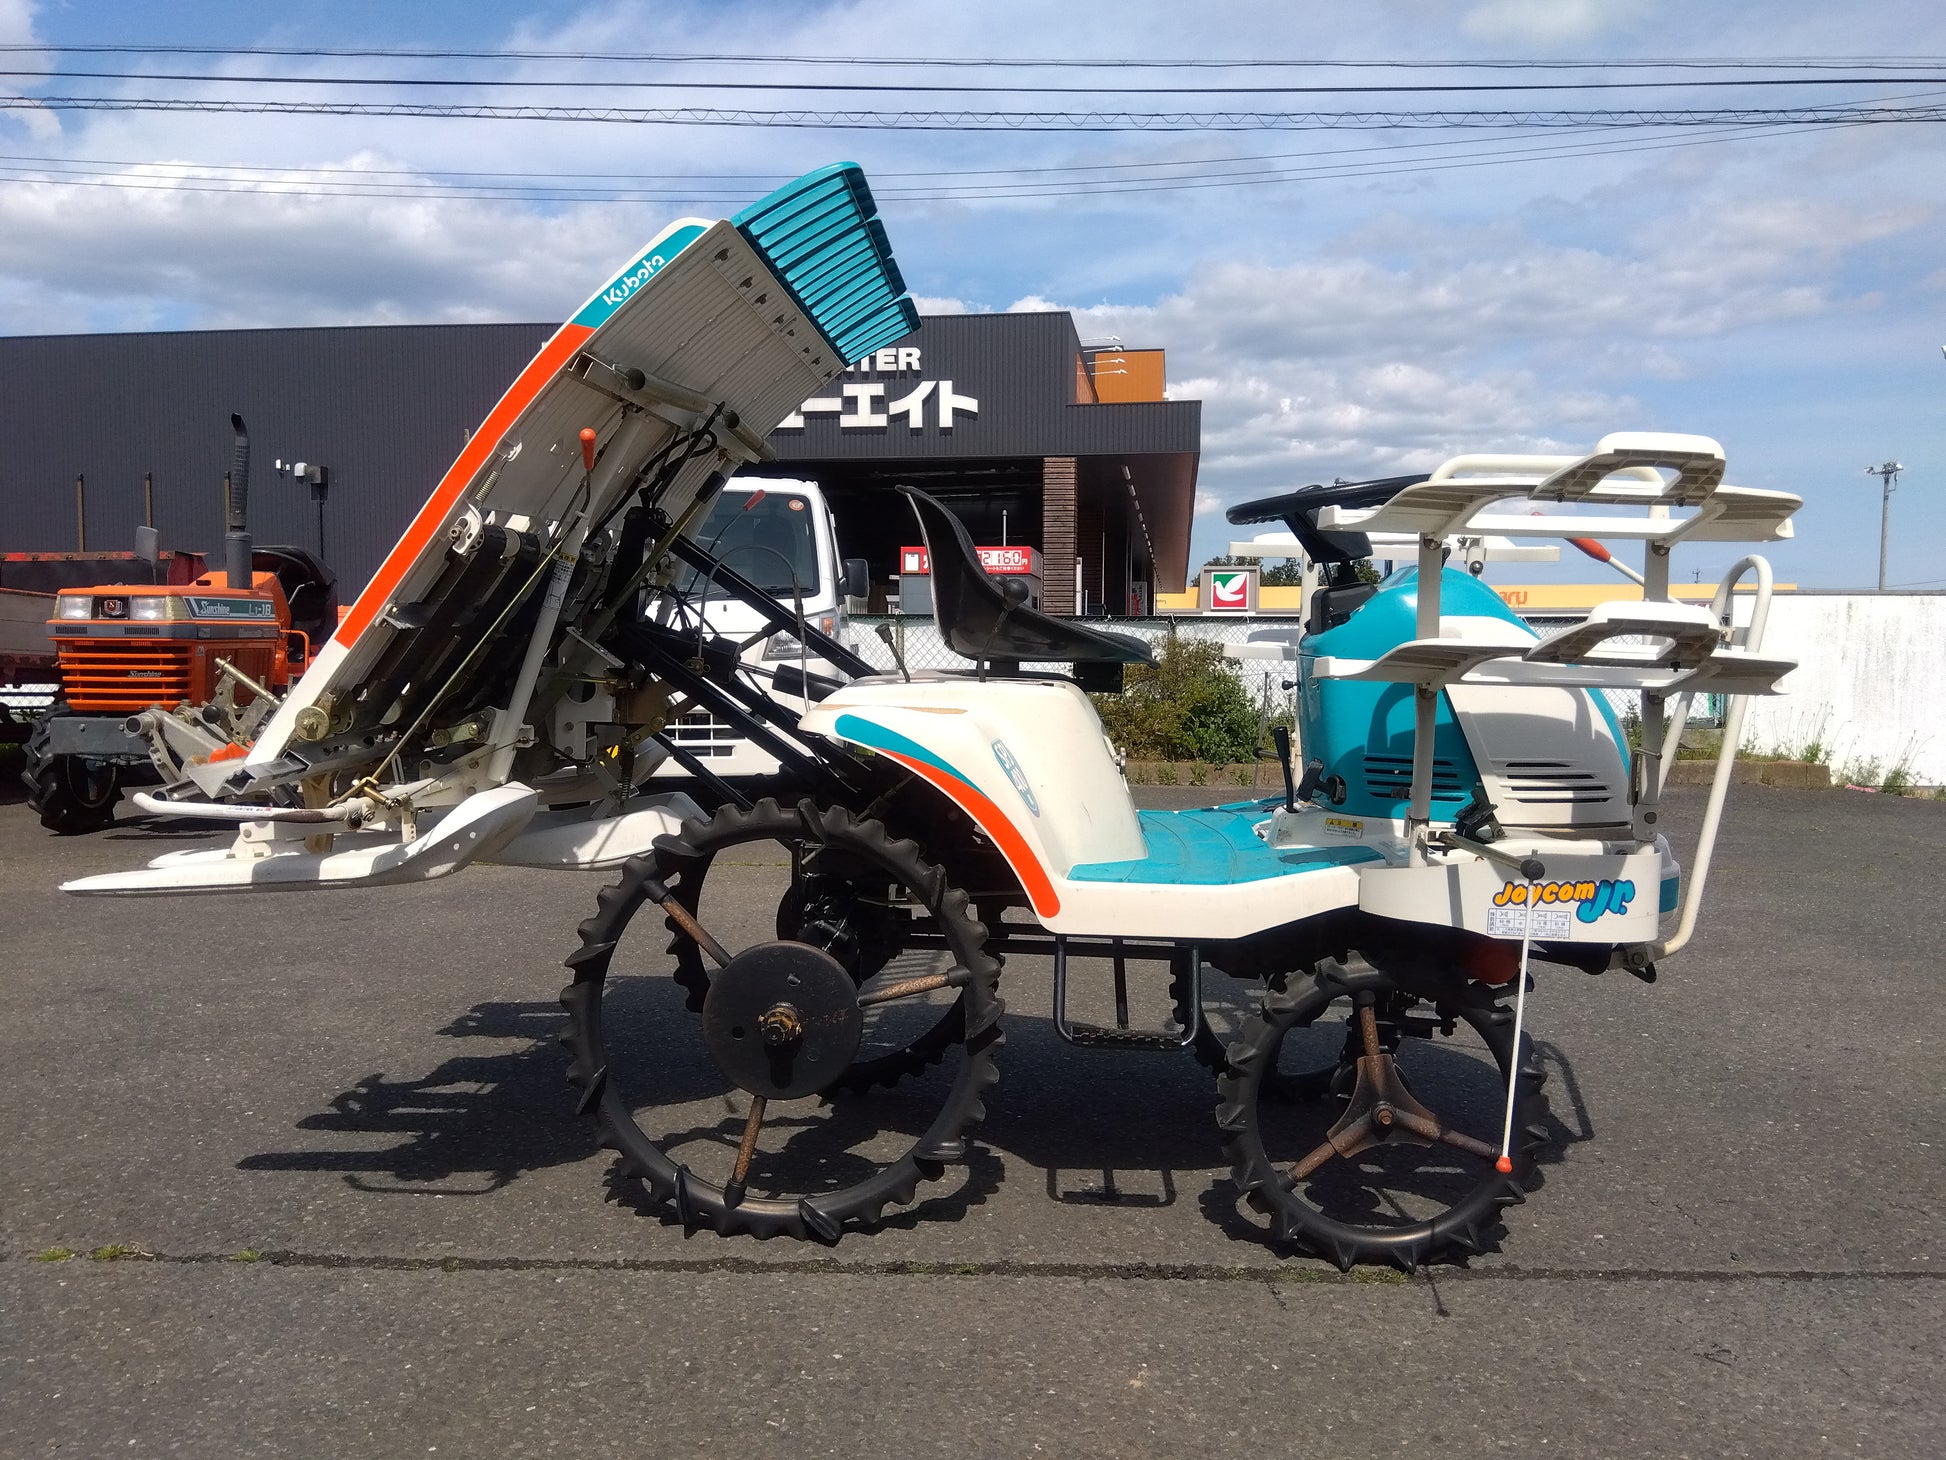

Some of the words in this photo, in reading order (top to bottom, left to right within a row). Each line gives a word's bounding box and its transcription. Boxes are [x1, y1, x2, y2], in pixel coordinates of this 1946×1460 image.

[602, 255, 665, 306] Kubota
[845, 348, 921, 371] TER
[201, 600, 230, 615] Sunshine
